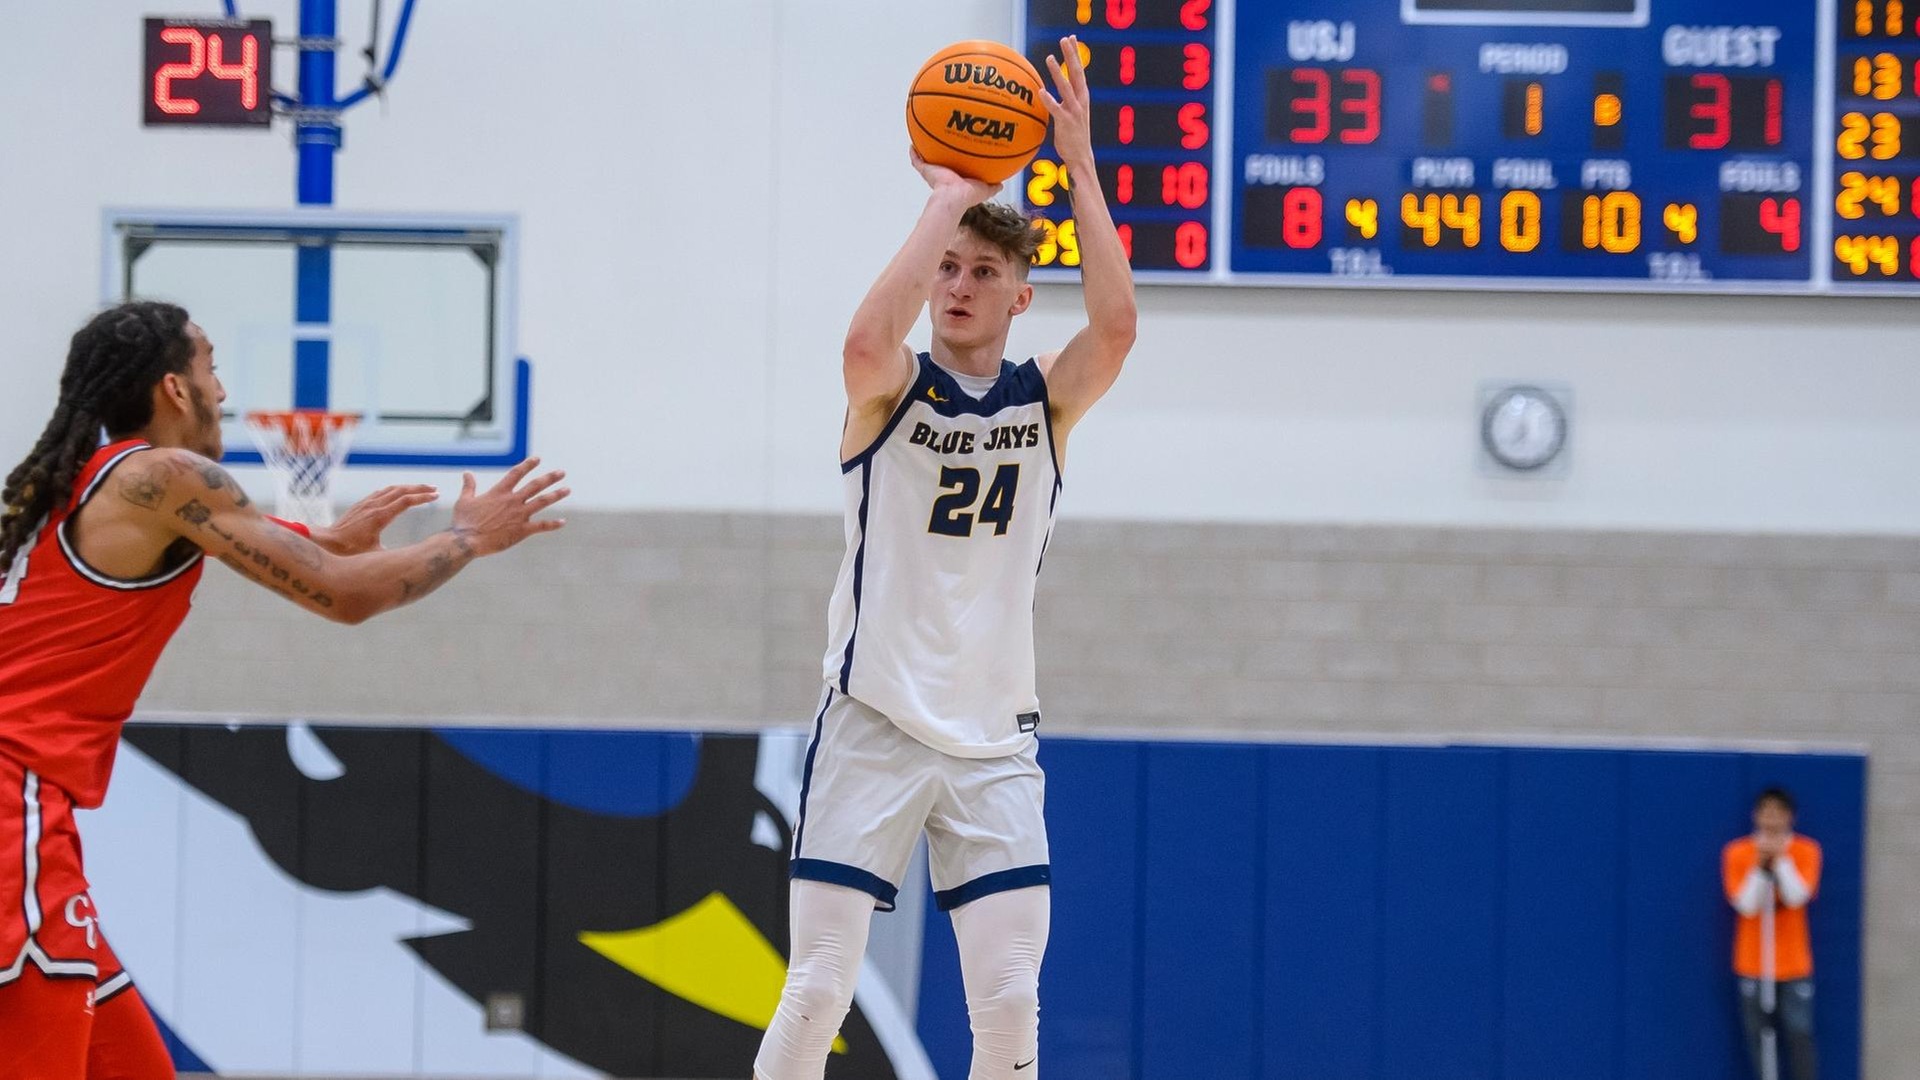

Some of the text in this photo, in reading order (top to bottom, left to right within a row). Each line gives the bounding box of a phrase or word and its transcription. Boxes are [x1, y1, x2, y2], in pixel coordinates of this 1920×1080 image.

[1287, 20, 1356, 61] USJ
[1855, 0, 1904, 37] 11
[1120, 46, 1136, 86] 1
[1182, 43, 1210, 90] 3
[1478, 43, 1568, 74] PERIOD
[1662, 25, 1781, 67] GUEST
[154, 28, 258, 114] 24
[944, 63, 1033, 106] Wilson
[1854, 52, 1902, 100] 13
[946, 110, 1016, 142] NCAA
[1118, 102, 1209, 149] 1 5
[1289, 67, 1382, 144] 33
[1525, 83, 1543, 136] 1
[1689, 73, 1782, 149] 31
[1836, 112, 1901, 160] 23
[1027, 159, 1208, 209] 2 1 10
[1244, 154, 1325, 186] FOULS
[1492, 157, 1558, 189] FOUL
[1581, 159, 1631, 190] PTS
[1719, 160, 1800, 192] FOULS
[1836, 171, 1900, 219] 24
[1282, 186, 1800, 253] 8 4 44 0 10 4 4
[1175, 221, 1208, 268] 0
[1834, 234, 1900, 276] 44
[909, 421, 1039, 454] BLUE JAYS
[927, 463, 1021, 537] 24
